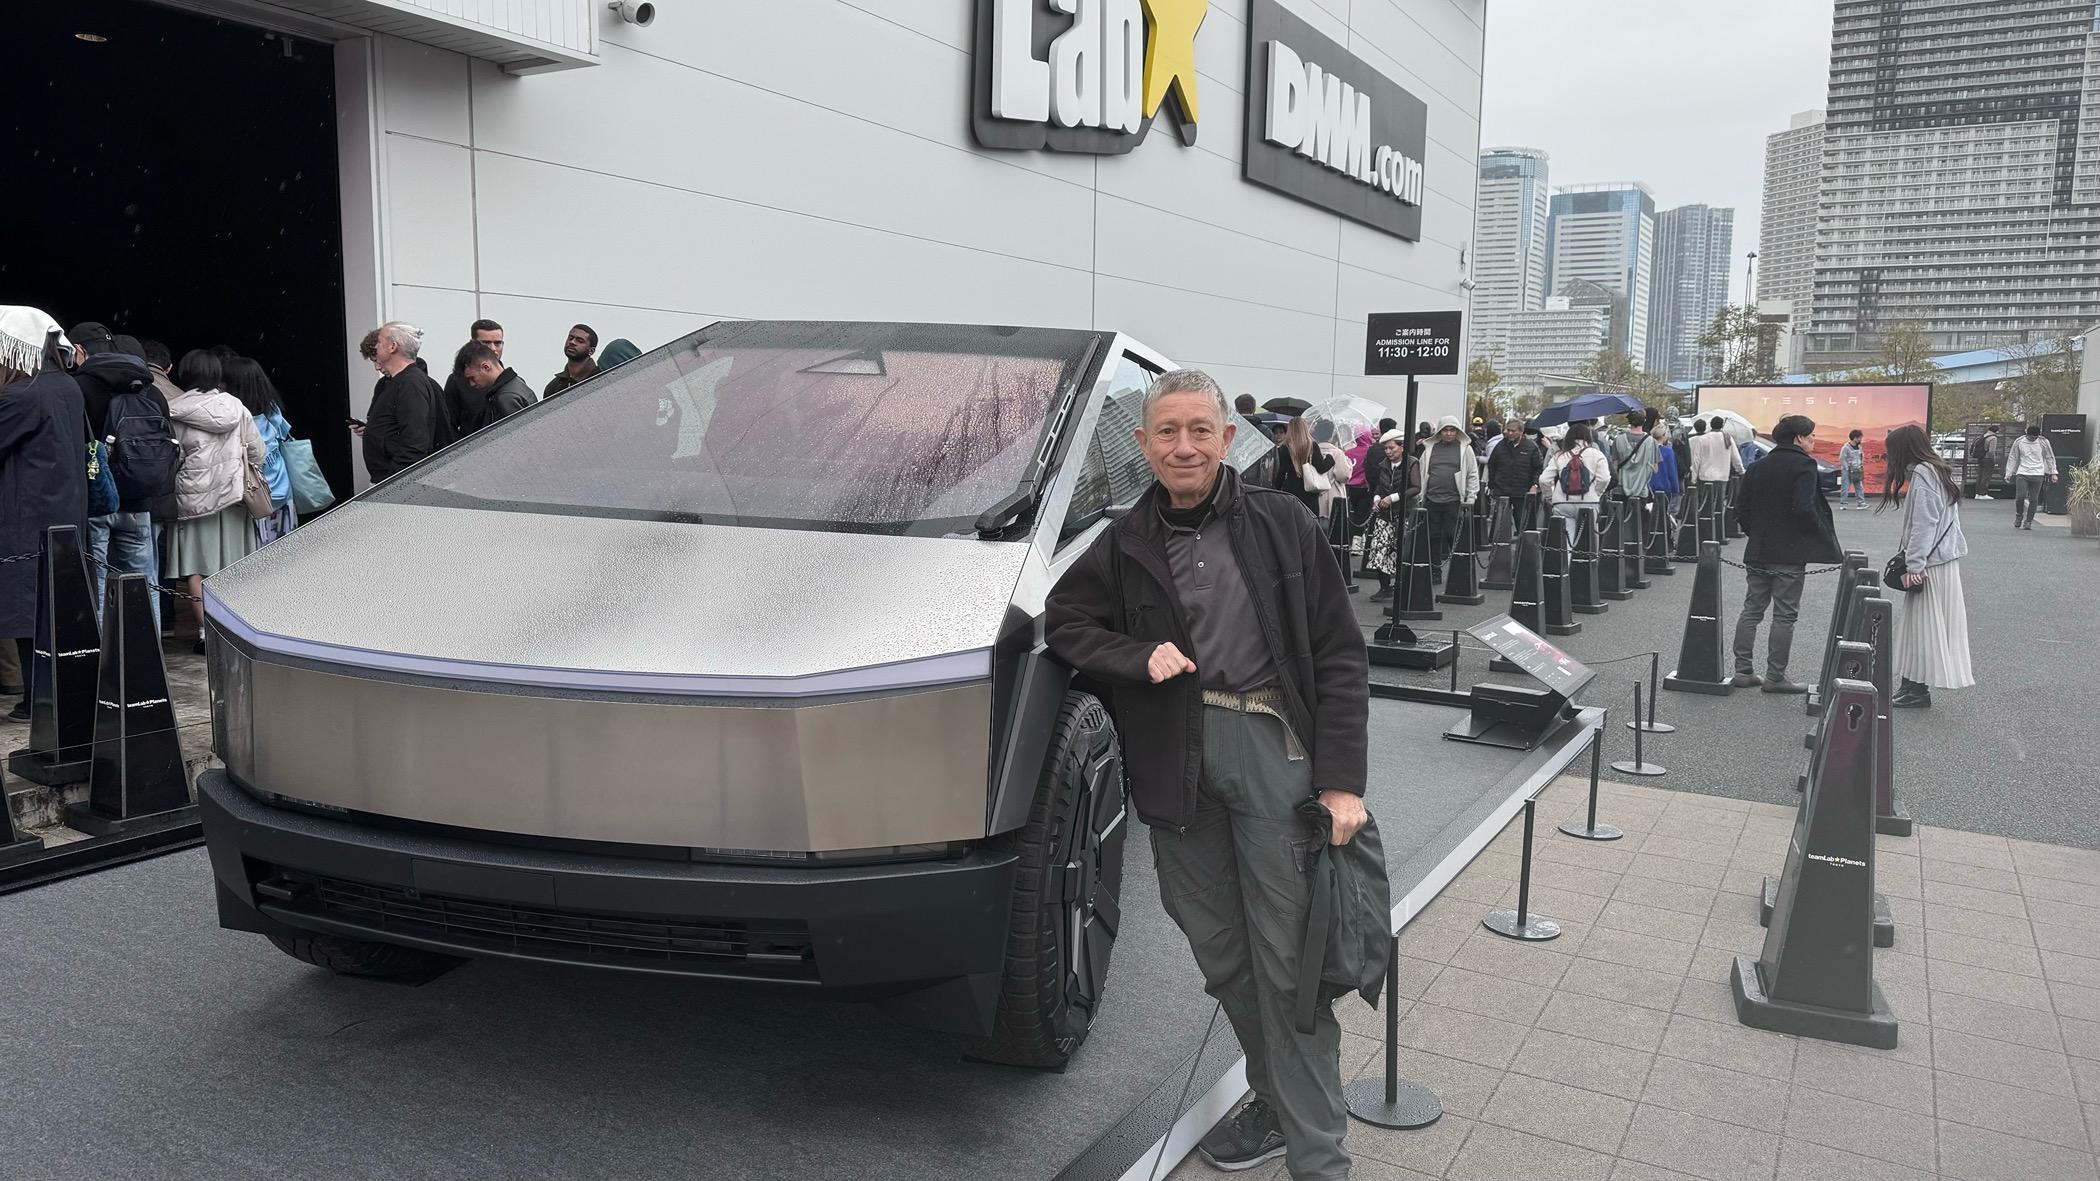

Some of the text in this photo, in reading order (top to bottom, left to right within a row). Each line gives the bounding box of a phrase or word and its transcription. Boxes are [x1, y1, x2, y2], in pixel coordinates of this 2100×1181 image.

[1265, 40, 1423, 207] DMM.com
[1395, 328, 1432, 336] ご案内時間
[1375, 338, 1415, 346] ADMISSION
[1378, 346, 1408, 358] 11:30
[1416, 345, 1449, 357] 12:00
[1760, 396, 1858, 405] TESLA
